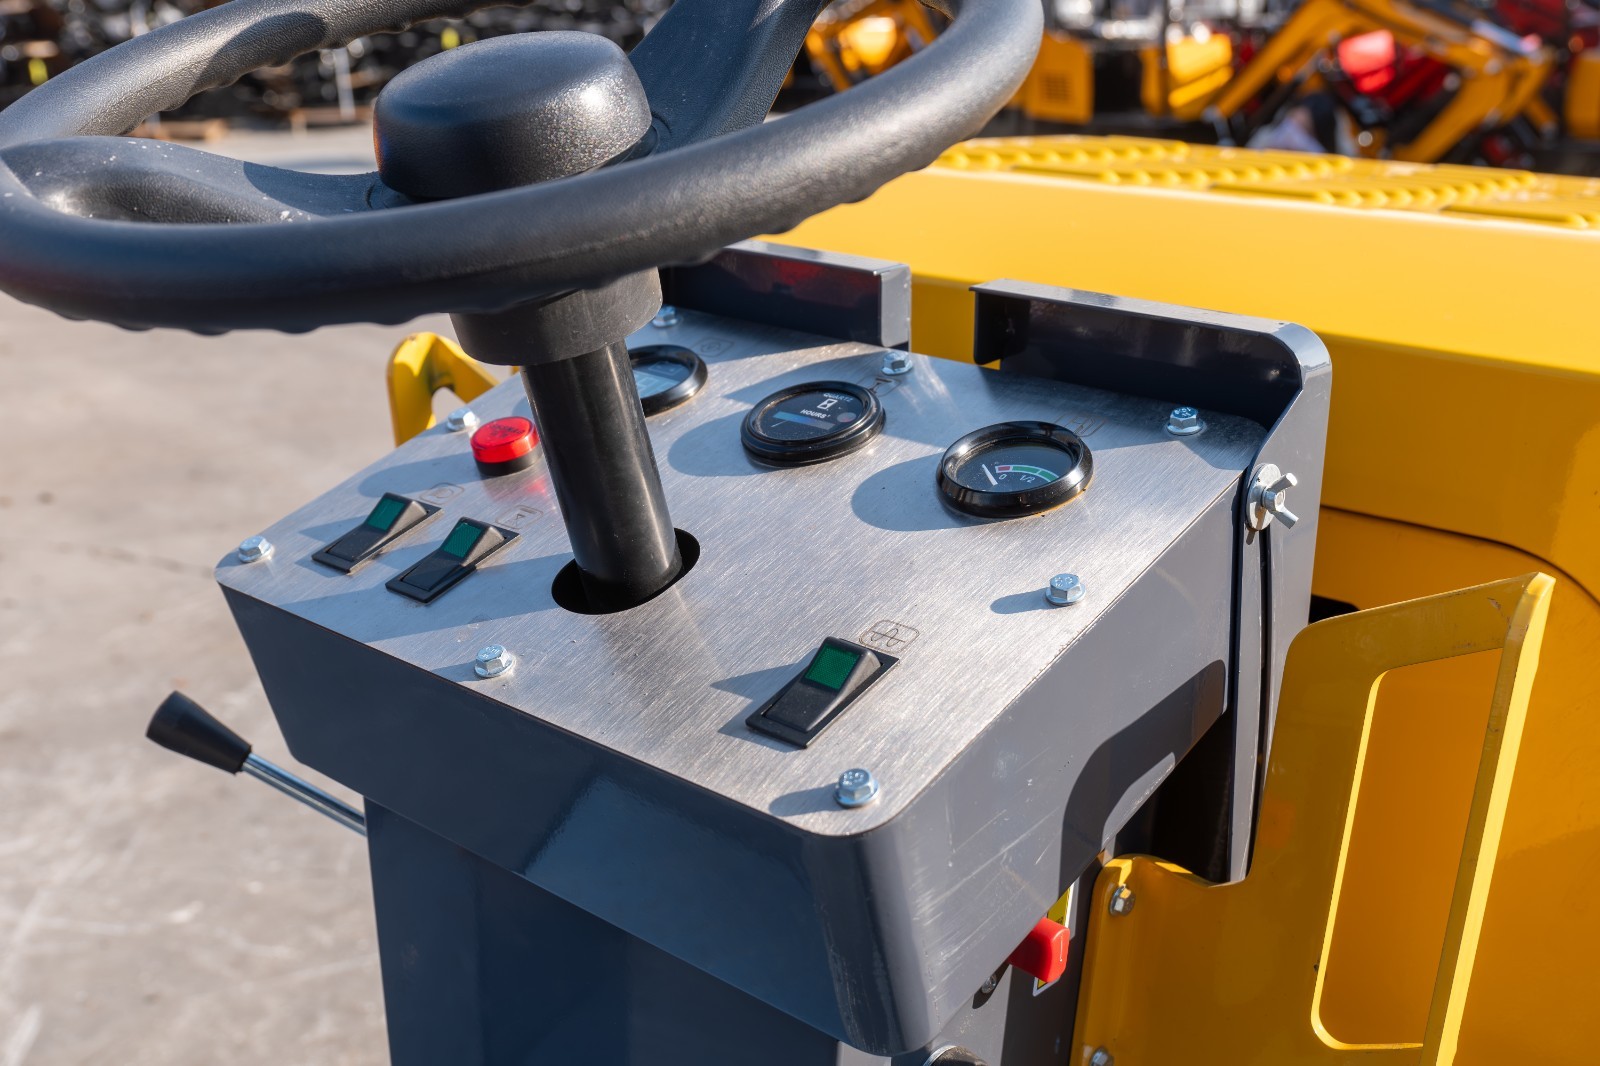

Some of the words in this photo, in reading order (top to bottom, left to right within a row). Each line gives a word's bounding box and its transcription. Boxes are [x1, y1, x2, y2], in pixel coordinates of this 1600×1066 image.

[823, 392, 853, 402] QUARTZ
[800, 409, 827, 419] HOURS
[1020, 474, 1036, 483] 1/2
